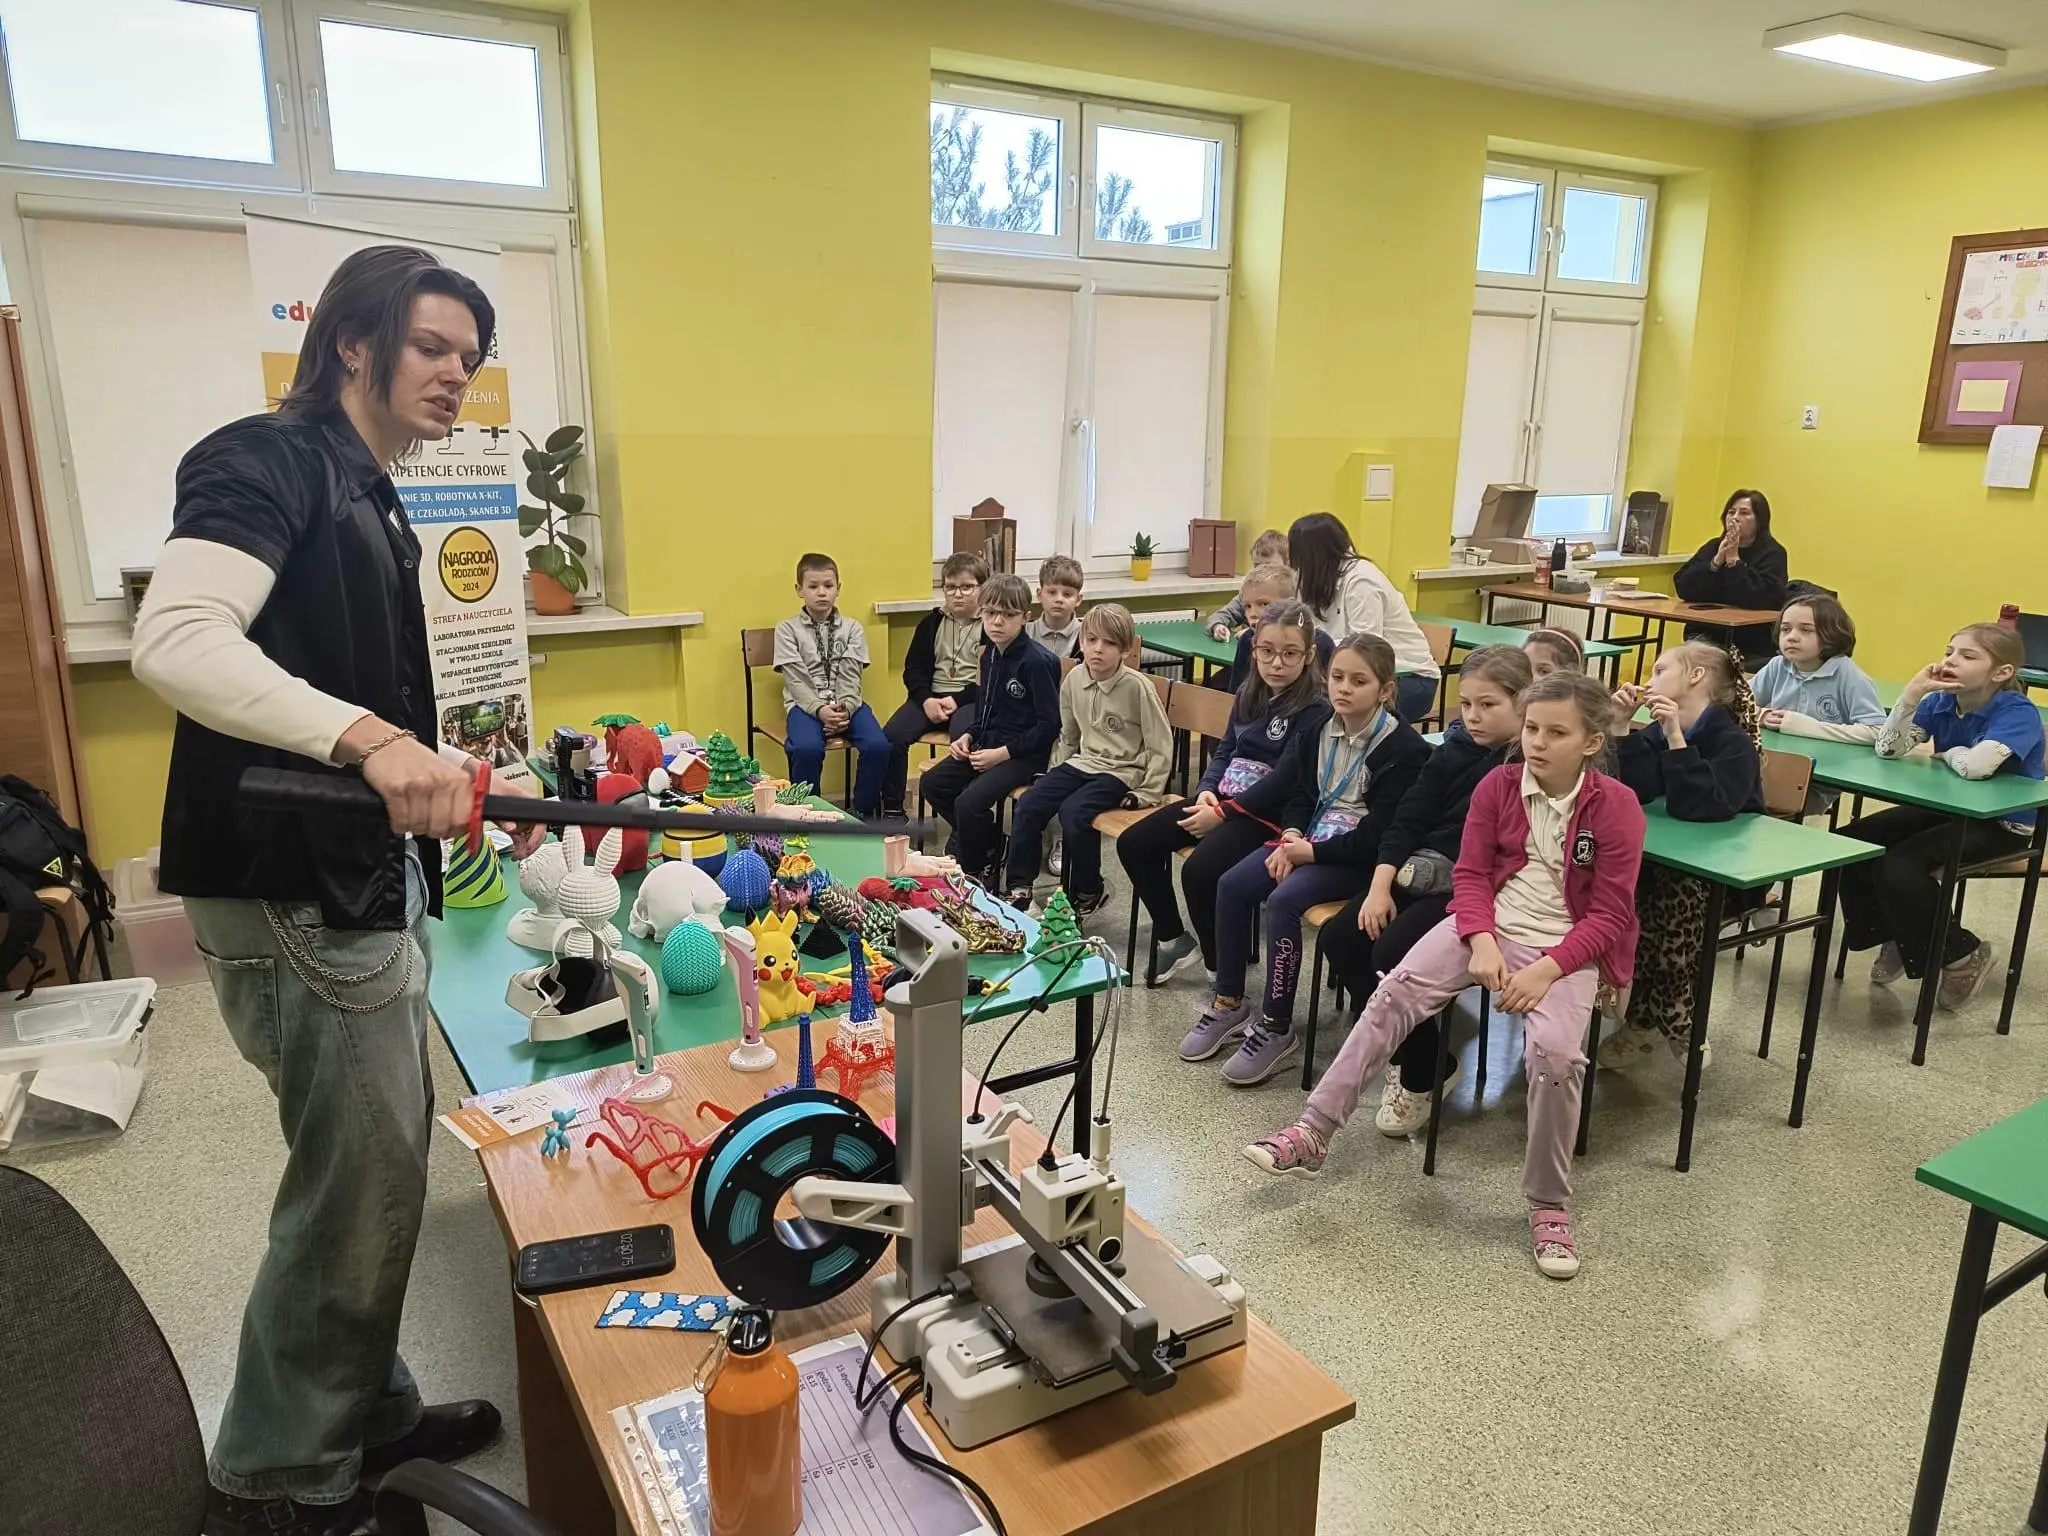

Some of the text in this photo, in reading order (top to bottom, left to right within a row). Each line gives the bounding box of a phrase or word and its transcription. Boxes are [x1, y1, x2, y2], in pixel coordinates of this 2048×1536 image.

[464, 390, 500, 404] ZENIA
[390, 465, 507, 477] MPETENCJE CYFROWE
[398, 493, 419, 503] ANIE
[435, 491, 477, 501] ROBOTYKA
[469, 506, 499, 516] SKANER
[502, 505, 511, 514] 3D
[443, 549, 495, 569] NAGRODA
[463, 582, 479, 591] 2024
[433, 607, 513, 625] STREFA NAUCZYCIELA
[434, 631, 476, 642] LABORATORIA
[436, 638, 513, 657] STACJONARNE SZKOLENIE
[456, 653, 480, 664] TWOJEJ
[481, 649, 503, 660] SZKOLE
[441, 659, 519, 679] WSPARCIE MERYTORYCZNE
[466, 672, 502, 685] TECHNICZNE
[435, 677, 527, 702] AKCJA: DZIEŃ TECHNOLOGICZNY
[1271, 938, 1293, 1000] Princess
[816, 1370, 833, 1393] godzina
[862, 1450, 875, 1469] klasa
